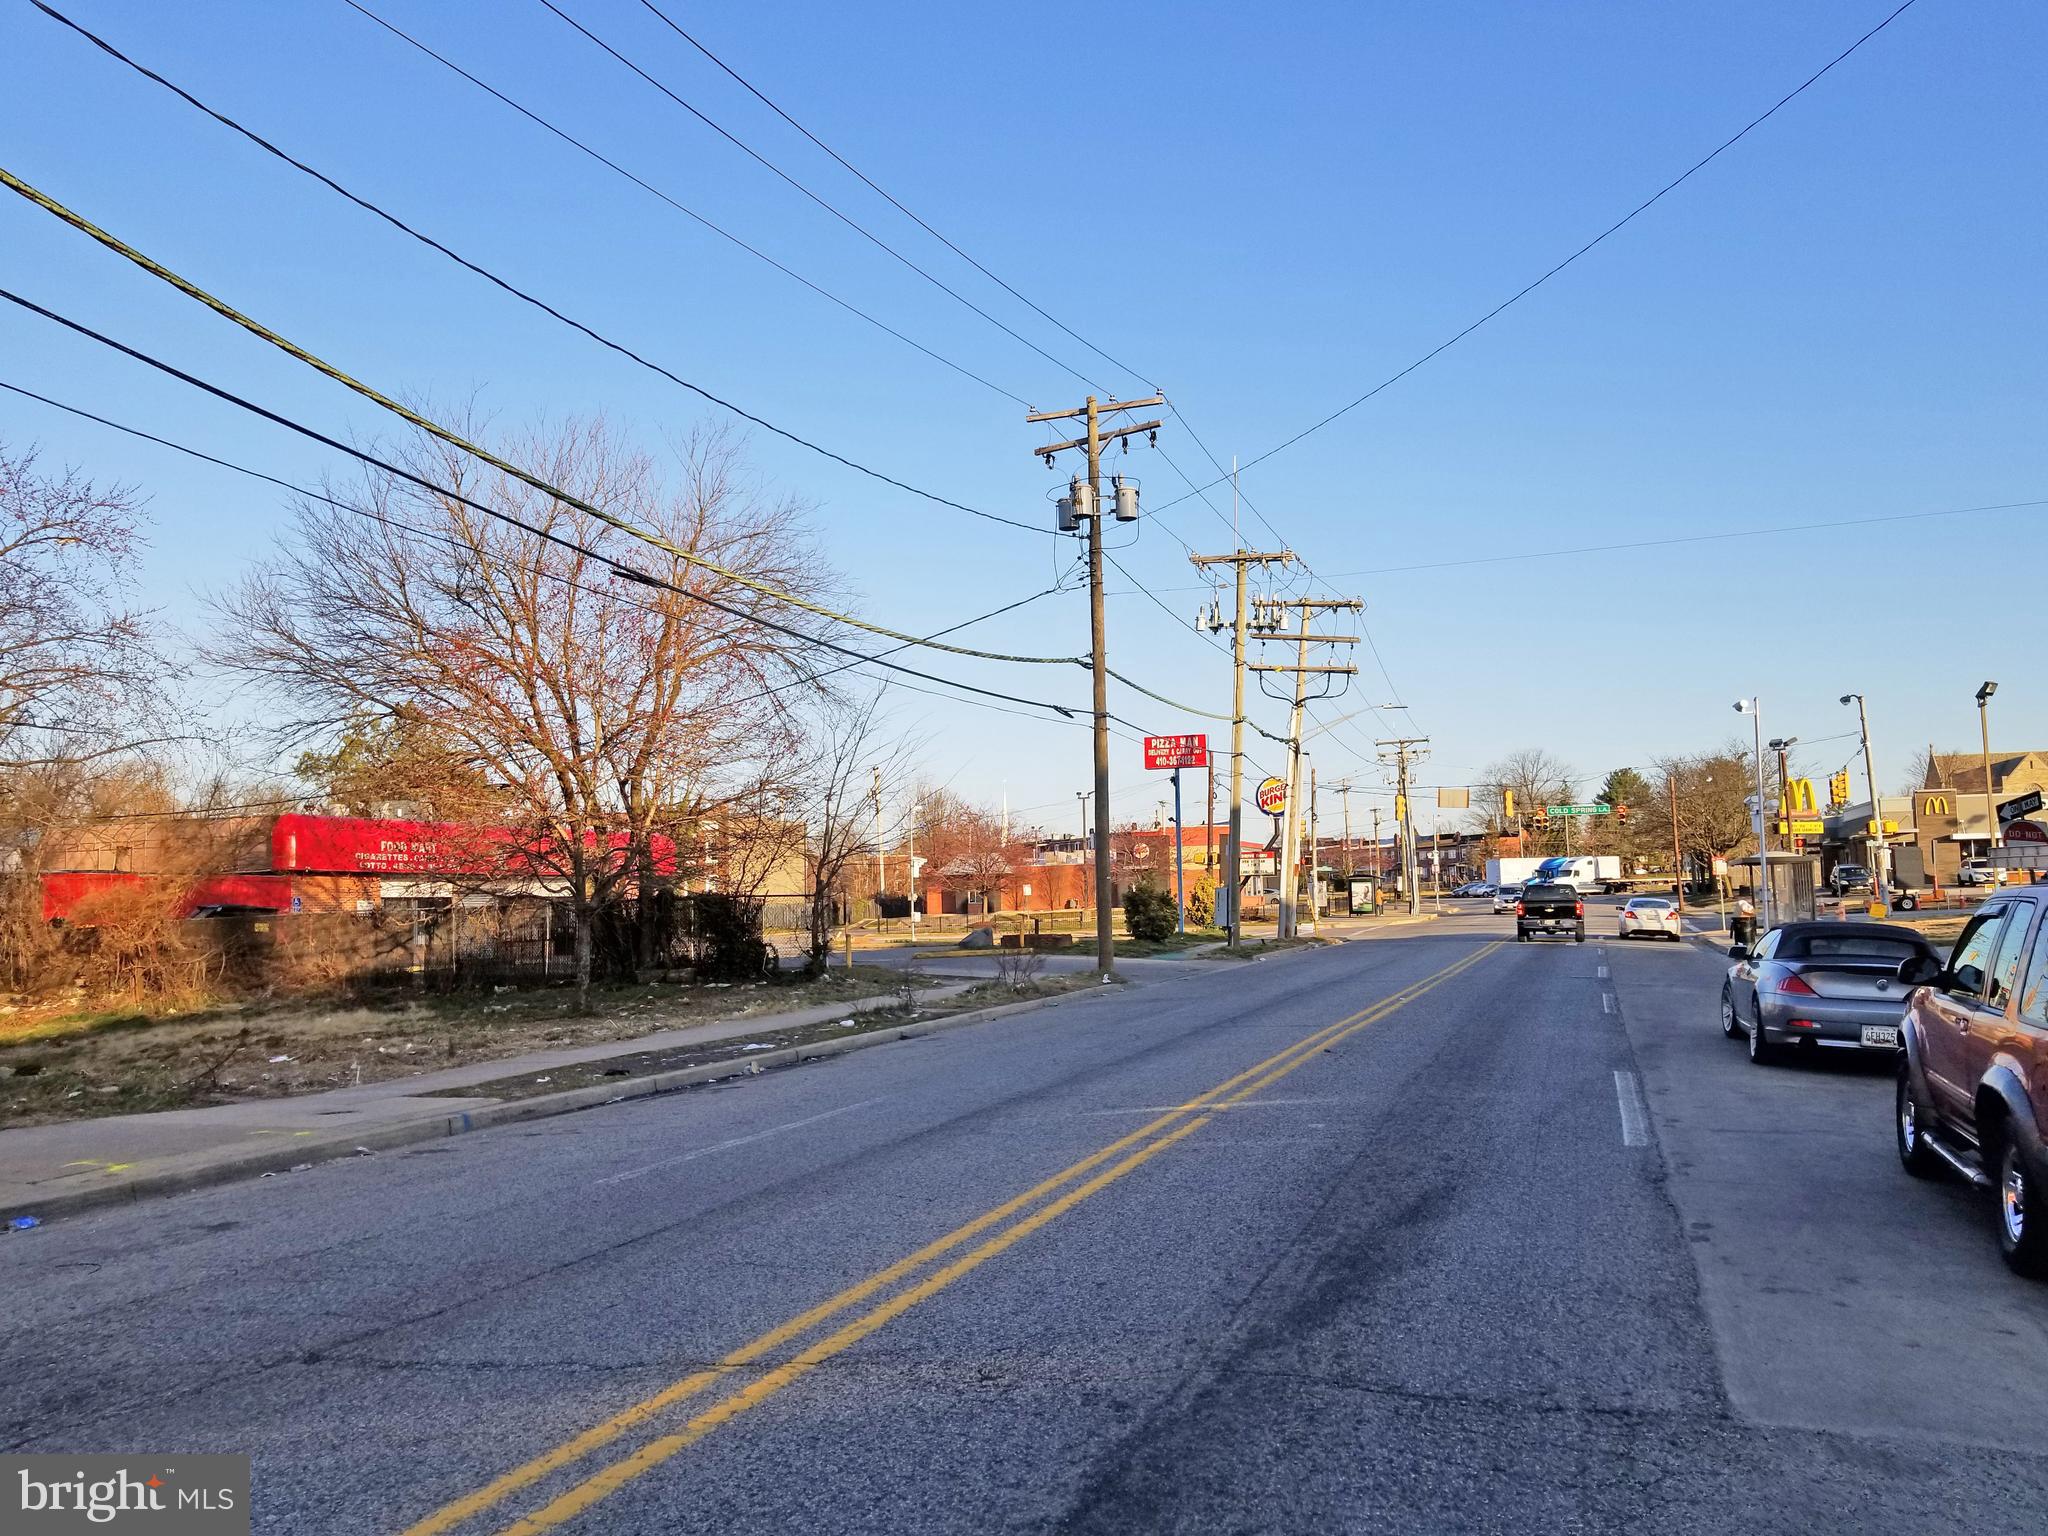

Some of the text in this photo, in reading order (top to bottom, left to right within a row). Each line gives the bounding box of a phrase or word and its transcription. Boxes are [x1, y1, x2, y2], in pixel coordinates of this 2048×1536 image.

[1151, 736, 1199, 749] PIZZA MAN
[1259, 783, 1287, 799] BURGE
[2009, 830, 2042, 840] DO NOT
[380, 840, 407, 852] FOOD
